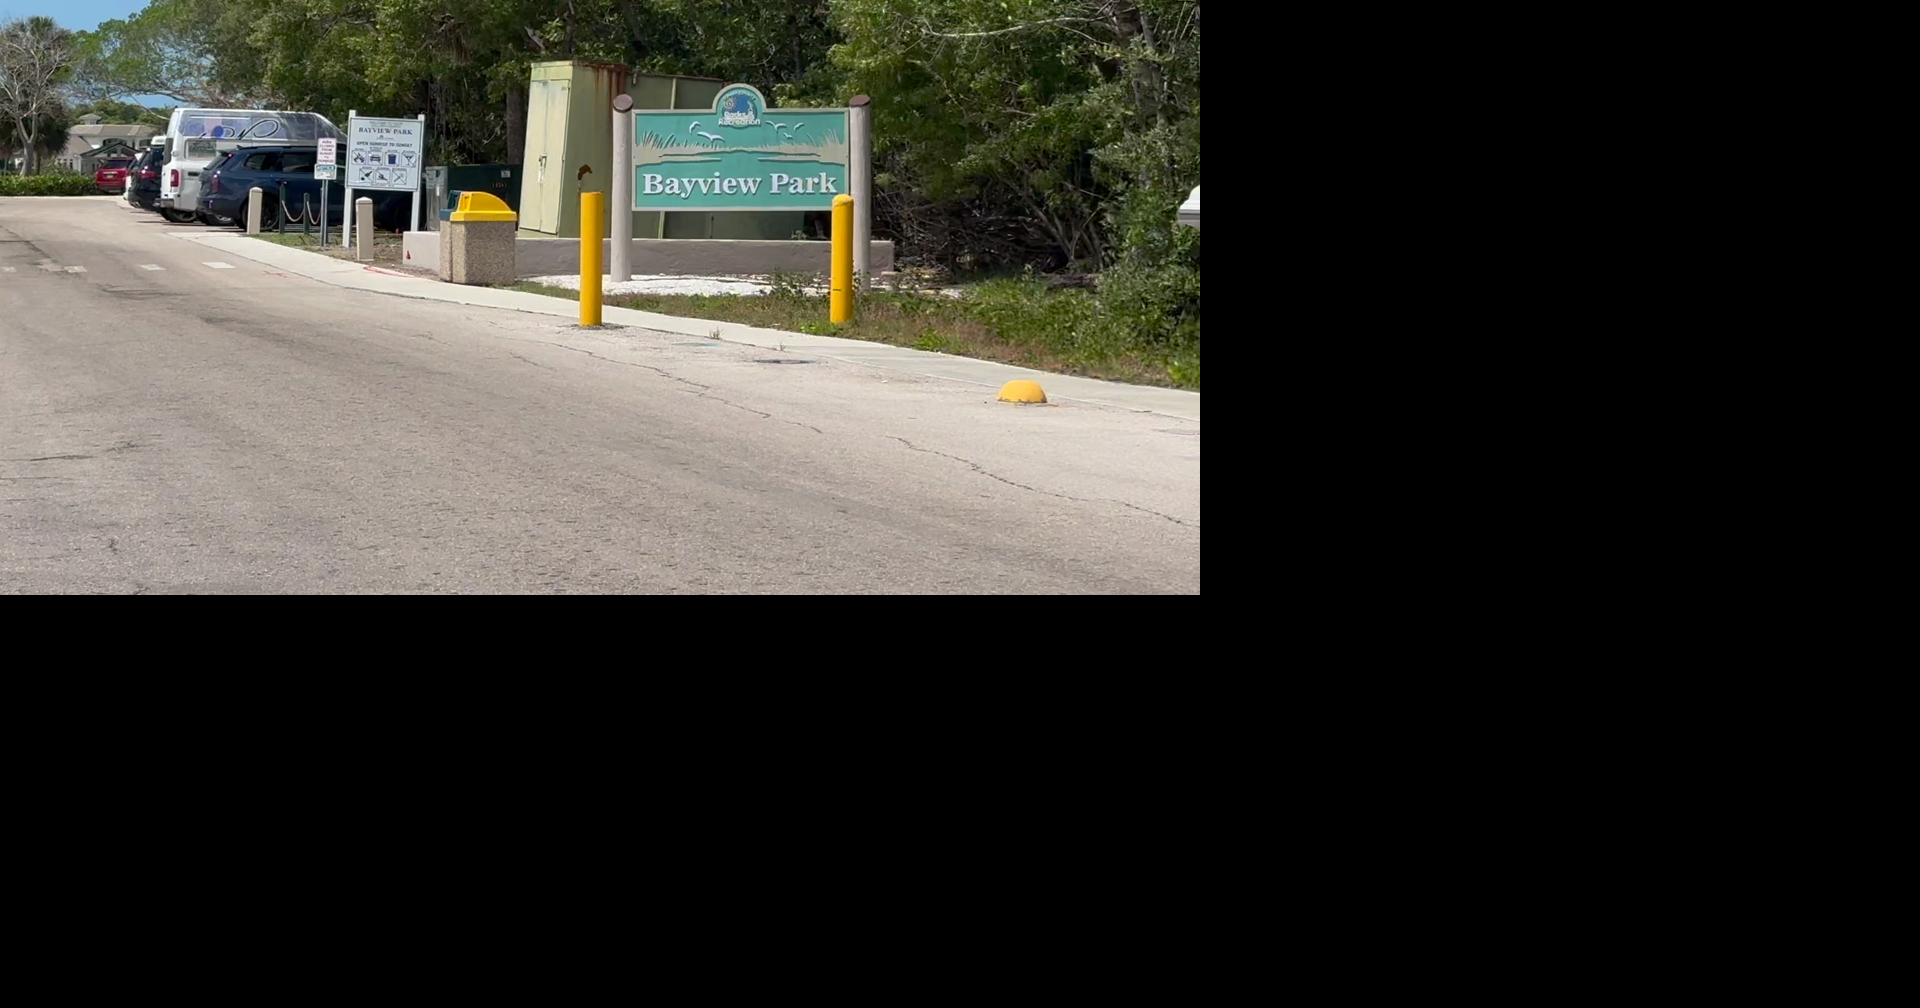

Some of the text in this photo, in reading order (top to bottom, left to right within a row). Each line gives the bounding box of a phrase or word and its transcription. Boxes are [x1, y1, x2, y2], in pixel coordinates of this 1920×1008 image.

[718, 118, 761, 126] Recreation
[643, 171, 837, 199] Bayview Park
